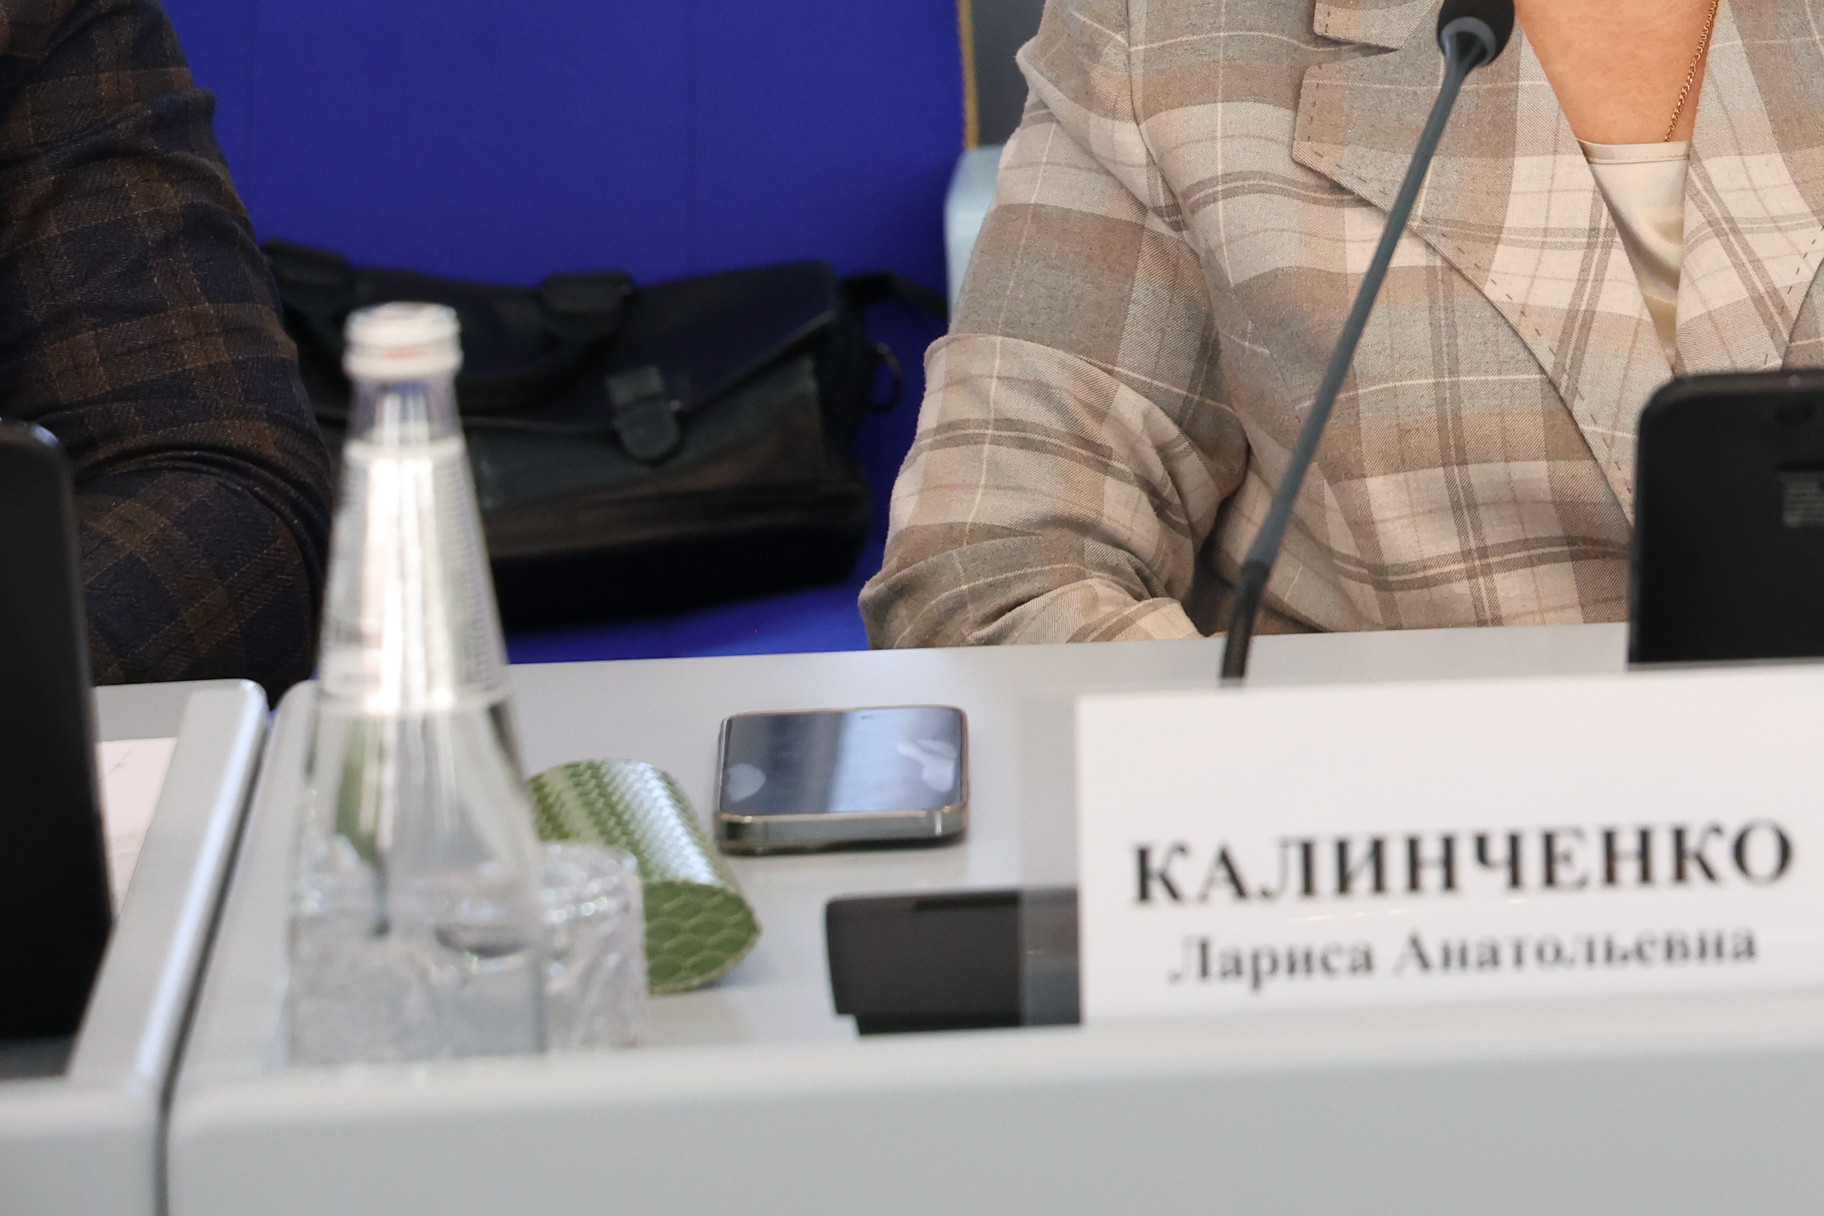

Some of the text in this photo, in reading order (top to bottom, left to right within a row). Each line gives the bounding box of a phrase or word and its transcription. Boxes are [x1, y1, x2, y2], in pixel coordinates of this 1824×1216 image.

[1132, 819, 1794, 905] КАЛИНЧЕНКО
[1170, 928, 1757, 992] Лариса Анатольевна
